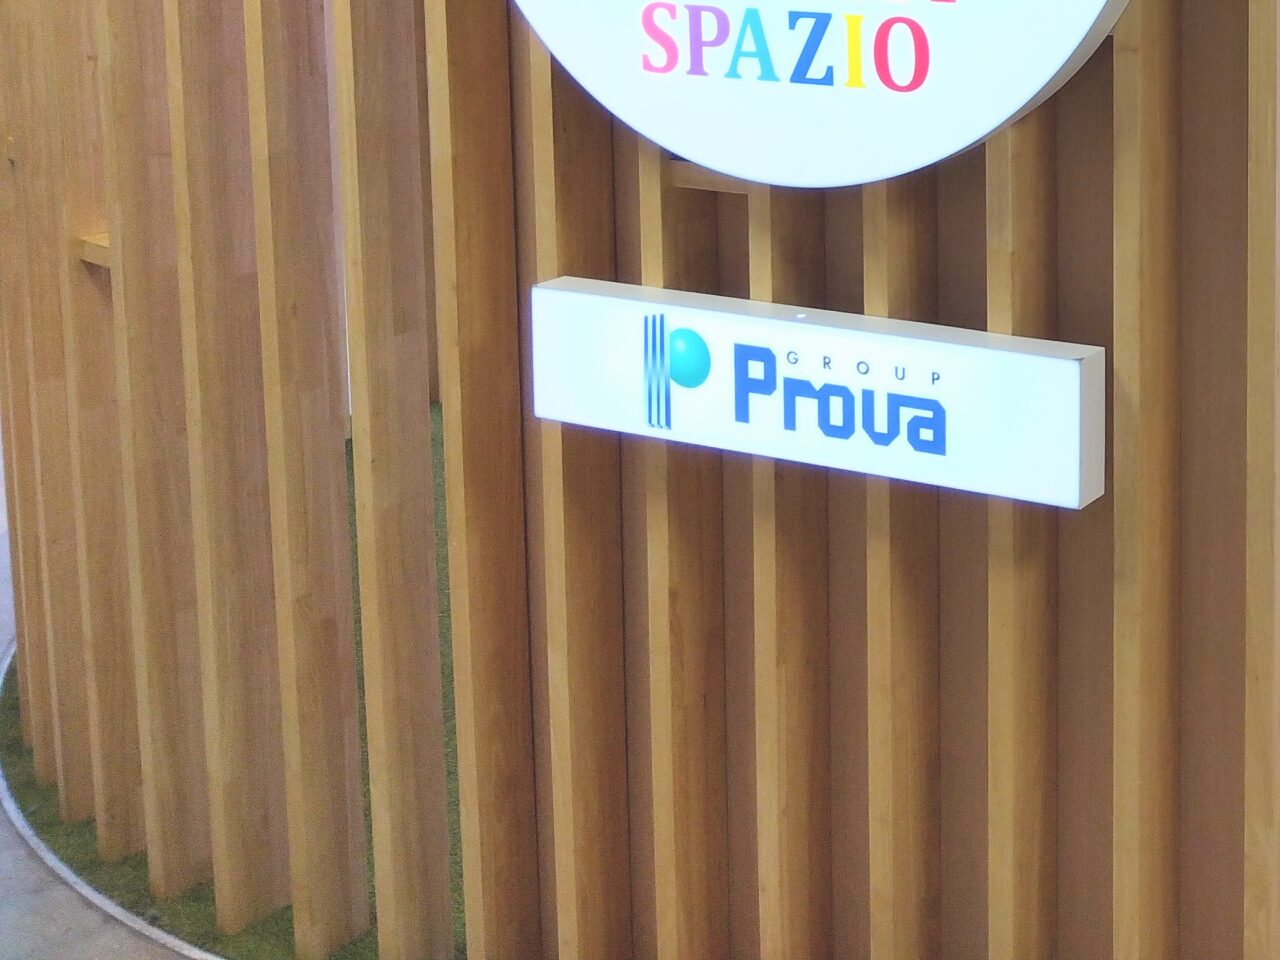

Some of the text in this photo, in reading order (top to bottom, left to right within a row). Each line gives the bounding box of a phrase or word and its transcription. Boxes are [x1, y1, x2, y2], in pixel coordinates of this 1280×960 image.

[641, 1, 930, 93] SPAZIO
[733, 342, 946, 456] Prova
[786, 350, 941, 386] GROUP
